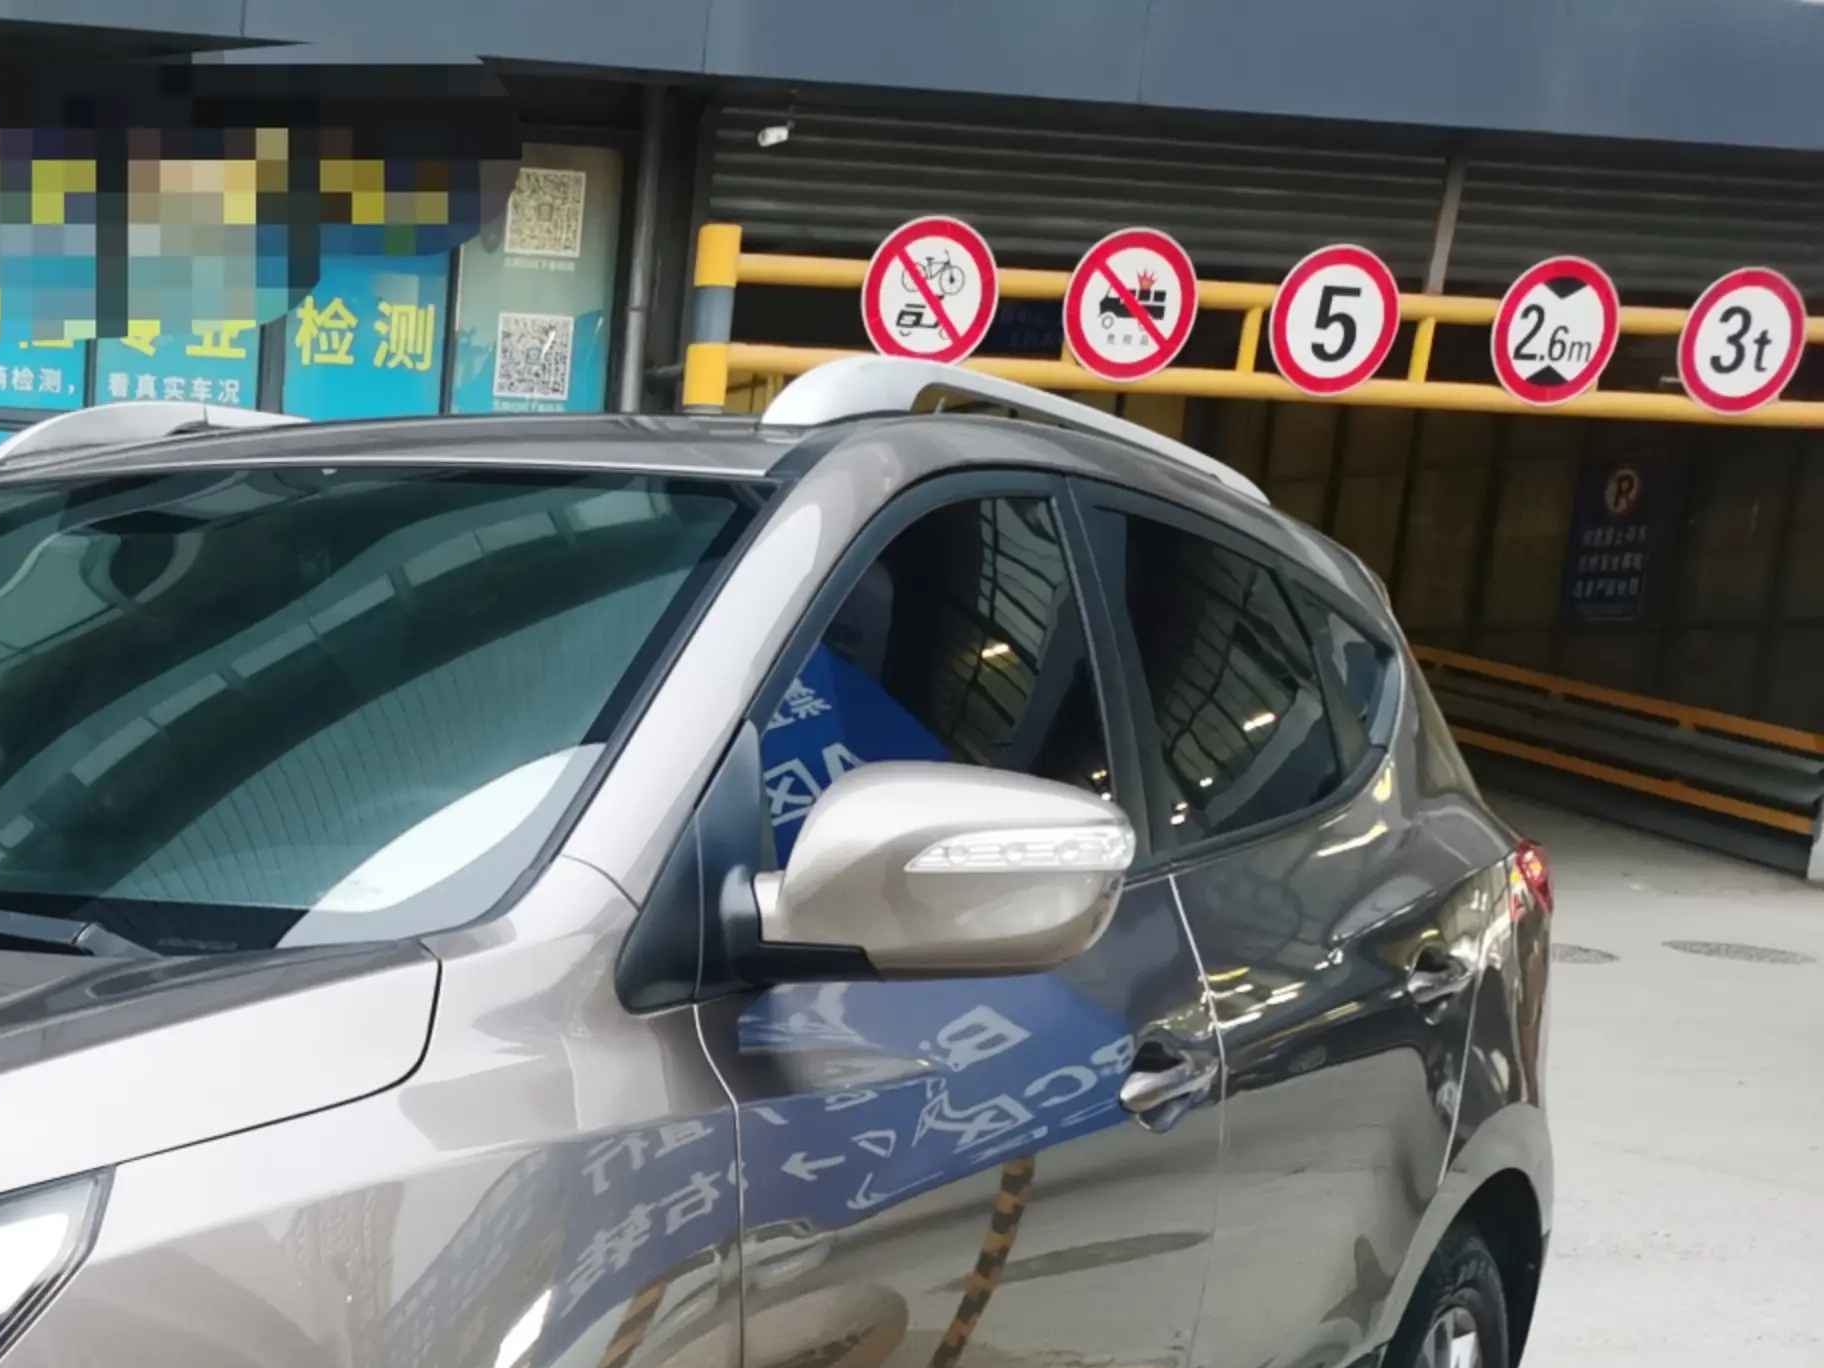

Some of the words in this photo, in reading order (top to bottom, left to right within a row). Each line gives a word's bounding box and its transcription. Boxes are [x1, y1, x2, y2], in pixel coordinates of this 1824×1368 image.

[295, 296, 435, 371] 检测
[1311, 285, 1362, 362] 5
[1513, 303, 1592, 362] 2.6m
[1709, 306, 1772, 374] 3t
[108, 372, 241, 402] 看真实车况
